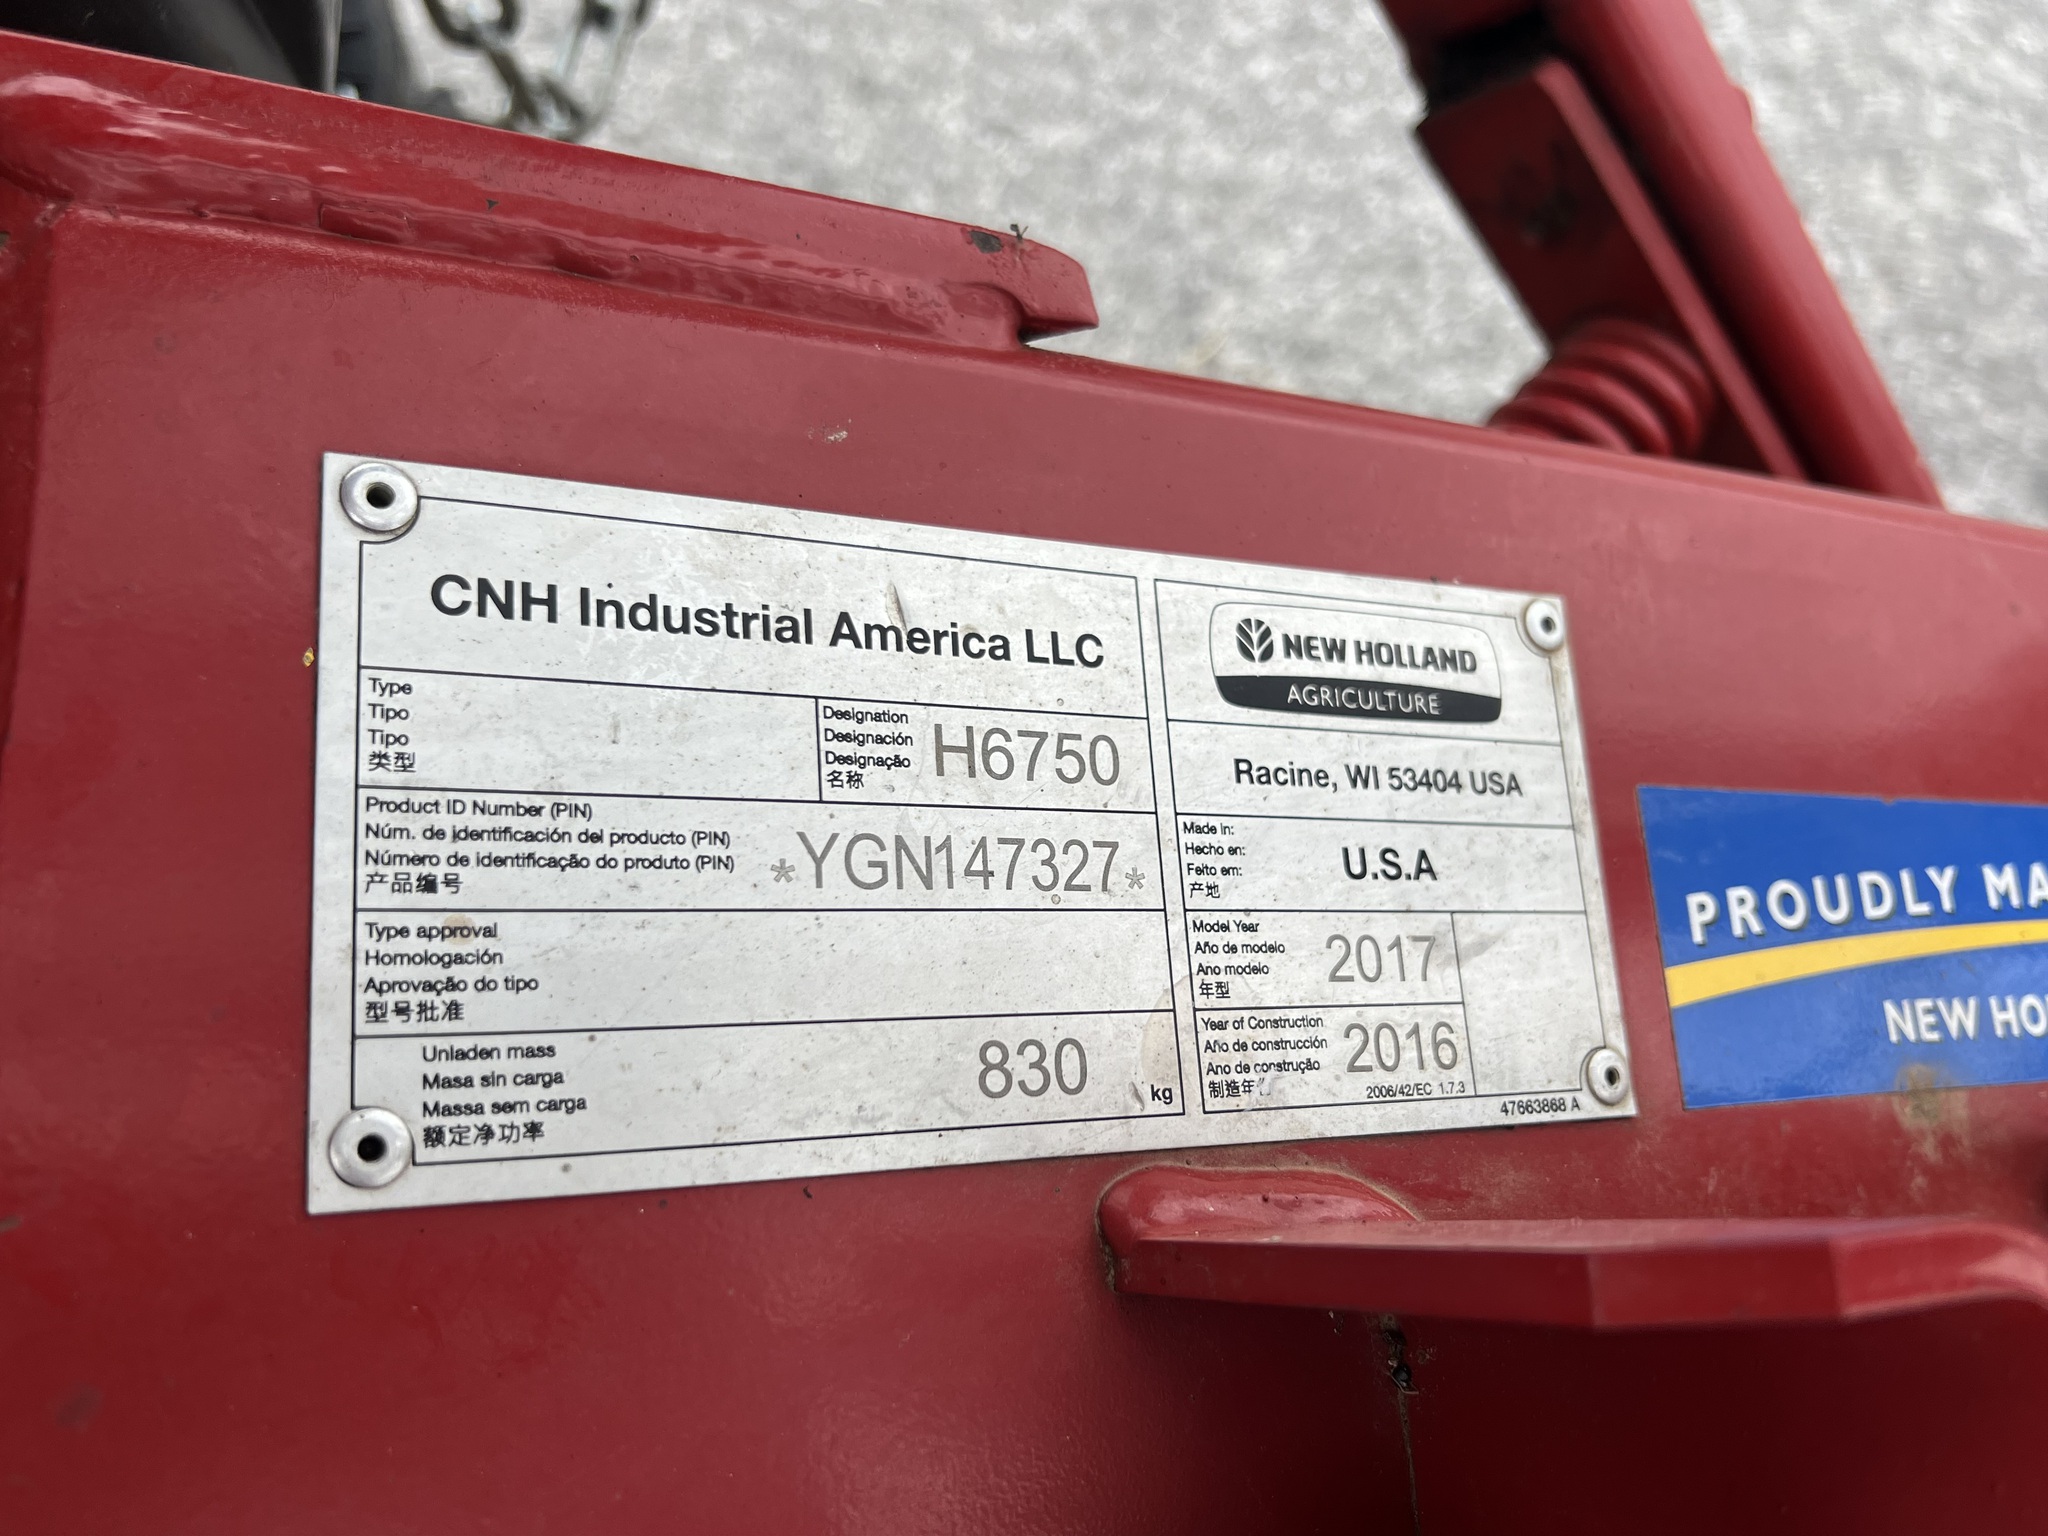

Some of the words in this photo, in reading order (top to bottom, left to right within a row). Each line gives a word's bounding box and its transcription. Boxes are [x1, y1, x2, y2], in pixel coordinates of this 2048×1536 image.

[430, 573, 558, 624] CNH
[580, 586, 813, 645] Industrial
[829, 610, 1011, 662] America
[1024, 628, 1105, 668] LLC
[1281, 633, 1346, 663] NEW
[1354, 640, 1478, 673] HOLLAND
[368, 677, 413, 697] Type
[1286, 683, 1441, 716] AGRICULTURE
[368, 702, 409, 723] Tipo
[823, 705, 909, 724] Designation
[368, 728, 409, 748] Tipo
[824, 728, 913, 747] Designación
[368, 750, 416, 773] 类型
[825, 750, 911, 770] Designação
[934, 723, 1120, 786] H6750
[827, 770, 865, 789] 名称
[1233, 758, 1337, 793] Racine,
[1346, 764, 1379, 790] WI
[1388, 767, 1462, 793] 53404
[1470, 770, 1523, 797] USA
[366, 796, 441, 815] Product
[447, 799, 467, 815] ID
[473, 800, 546, 817] Number
[551, 802, 593, 822] (PIN)
[365, 822, 416, 840] Núm.
[422, 824, 447, 840] de
[452, 825, 572, 843] identificación
[578, 829, 604, 844] del
[610, 830, 686, 847] producto
[691, 831, 731, 849] (PIN)
[1183, 821, 1218, 835] Made
[1220, 822, 1235, 836] in:
[1185, 841, 1225, 856] Hecho
[1227, 845, 1246, 856] en:
[365, 849, 441, 867] Número
[446, 851, 471, 867] de
[476, 851, 590, 872] identificação
[595, 854, 619, 869] do
[624, 855, 690, 872] produto
[695, 855, 735, 873] (PIN)
[1186, 862, 1217, 876] Feito
[1220, 865, 1243, 877] em:
[1341, 845, 1438, 882] U.S.A
[365, 871, 464, 895] 产品编号
[1189, 881, 1221, 899] 产地
[1685, 865, 1960, 945] PROUDLY
[1981, 861, 2048, 911] MA
[365, 922, 411, 941] Type
[416, 923, 498, 941] approval
[1192, 919, 1231, 933] Model
[1233, 919, 1260, 933] Year
[1194, 939, 1219, 954] Año
[1222, 940, 1238, 954] de
[1241, 939, 1286, 954] modelo
[364, 950, 503, 968] Homologación
[1325, 933, 1436, 983] 2017
[1196, 962, 1222, 976] Ano
[1224, 961, 1270, 975] modelo
[364, 977, 468, 996] Aprovação
[474, 976, 499, 992] do
[504, 976, 540, 994] tipo
[1198, 981, 1231, 999] 年型
[365, 1000, 465, 1023] 型号批准
[1883, 995, 1980, 1044] NEW
[1988, 993, 2048, 1040] HO
[1201, 1016, 1229, 1031] Year
[1232, 1015, 1245, 1030] of
[1248, 1015, 1324, 1030] Construction
[423, 1044, 501, 1062] Unladen
[506, 1044, 557, 1059] mass
[1204, 1038, 1229, 1054] Año
[1232, 1037, 1248, 1053] de
[1251, 1036, 1328, 1051] construcción
[1343, 1021, 1459, 1073] 2016
[978, 1038, 1088, 1099] 830
[1206, 1060, 1232, 1076] Ano
[1234, 1060, 1251, 1075] de
[1253, 1057, 1321, 1075] construção
[423, 1073, 475, 1090] Masa
[480, 1070, 507, 1087] sin
[512, 1071, 565, 1089] carga
[1208, 1078, 1272, 1098] 制造年
[1366, 1083, 1432, 1099] 2006/42/EC
[1440, 1081, 1466, 1095] 1.7.3
[1151, 1084, 1174, 1105] kg
[1570, 1095, 1581, 1111] A
[423, 1100, 486, 1118] Massa
[491, 1099, 530, 1114] sem
[536, 1095, 587, 1114] carga
